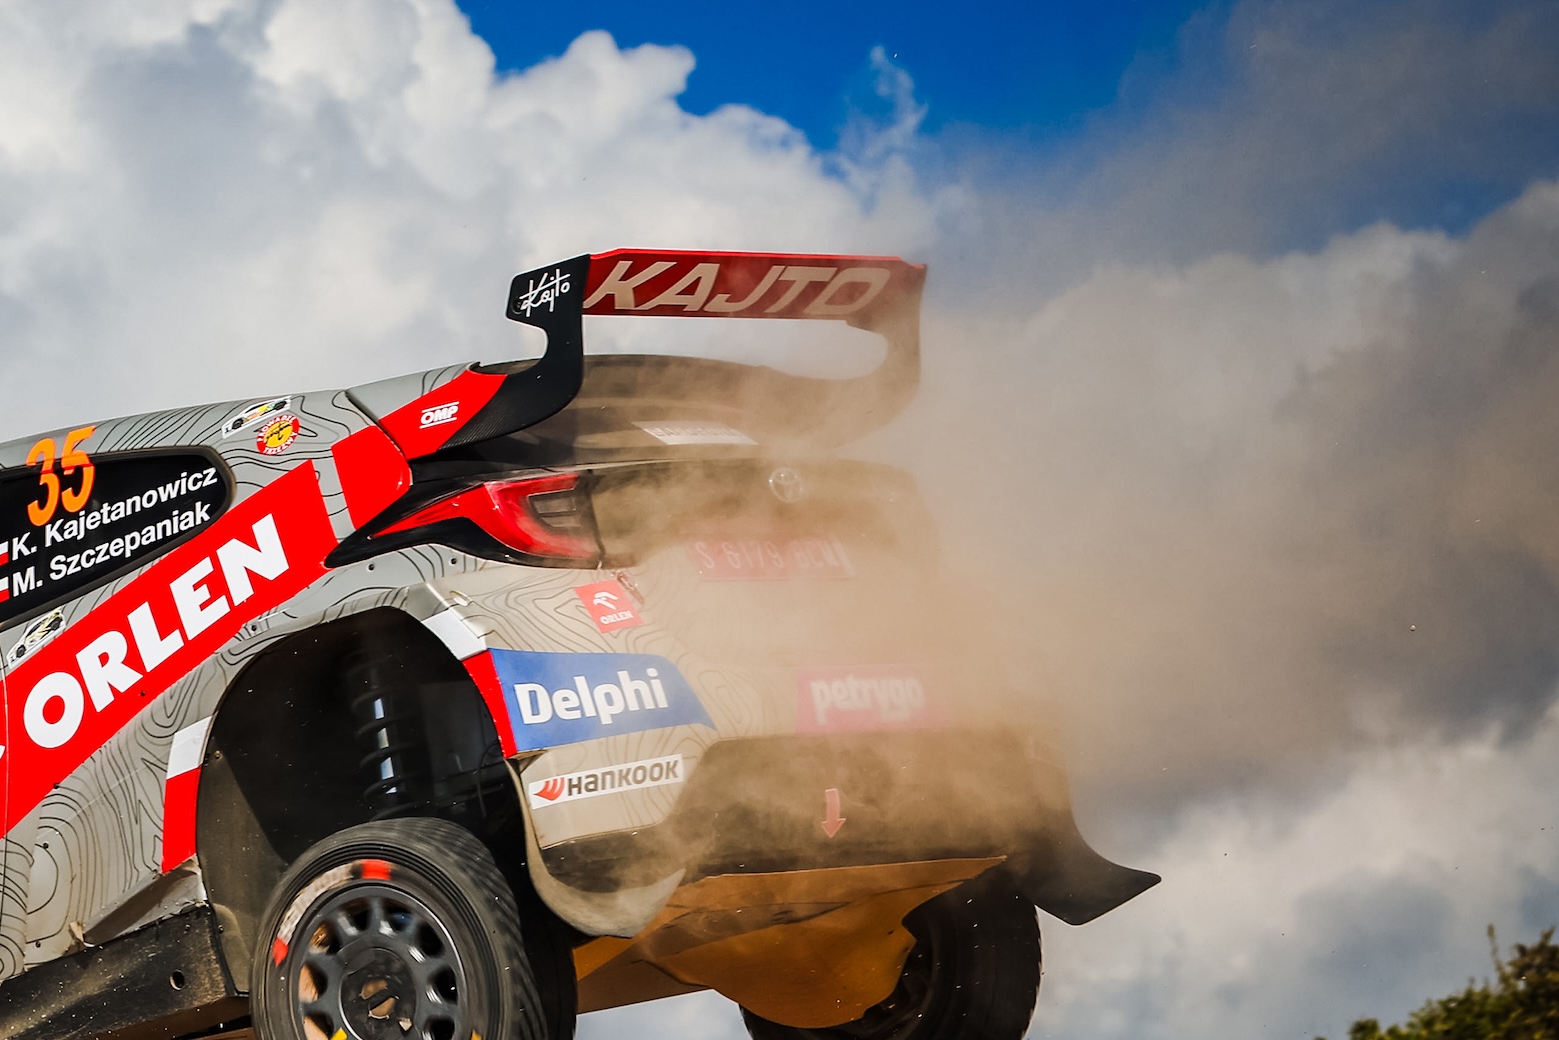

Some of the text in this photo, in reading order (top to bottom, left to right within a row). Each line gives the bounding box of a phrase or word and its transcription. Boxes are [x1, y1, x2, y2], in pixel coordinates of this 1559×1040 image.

[583, 260, 890, 316] KAJTO
[420, 404, 459, 425] OMP
[12, 467, 218, 561] K. Kajetanowicz
[26, 425, 97, 527] 35
[12, 501, 211, 597] M. Szczepaniak
[23, 513, 290, 748] ORLEN
[600, 610, 634, 625] ORLEN
[514, 667, 668, 725] Delphi
